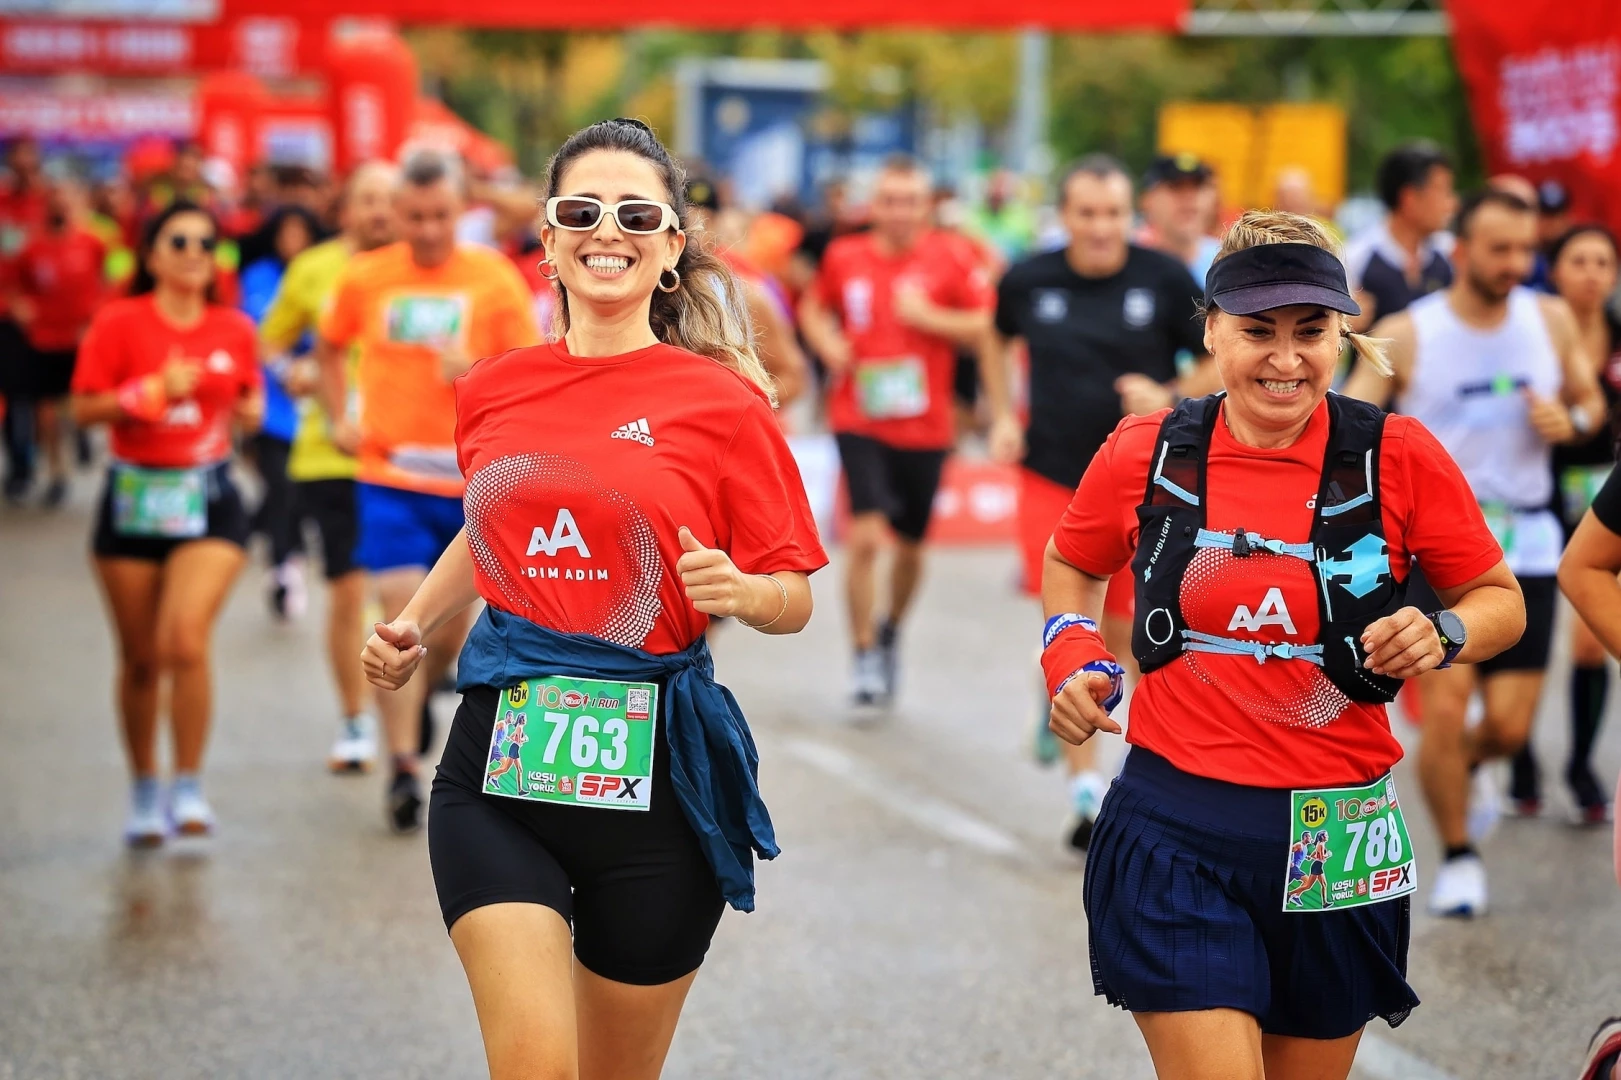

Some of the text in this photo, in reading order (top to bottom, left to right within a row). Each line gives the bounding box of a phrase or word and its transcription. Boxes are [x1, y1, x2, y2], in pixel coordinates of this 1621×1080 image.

[611, 430, 655, 447] adidas
[1149, 515, 1173, 565] RAIDLIGHT
[520, 566, 609, 581] DIM ADIM
[542, 711, 629, 771] 763
[527, 782, 556, 794] YORUZ
[579, 775, 643, 800] SPX
[1343, 811, 1402, 872] 788
[1372, 863, 1412, 893] SPX
[1332, 890, 1354, 901] YORUZ
